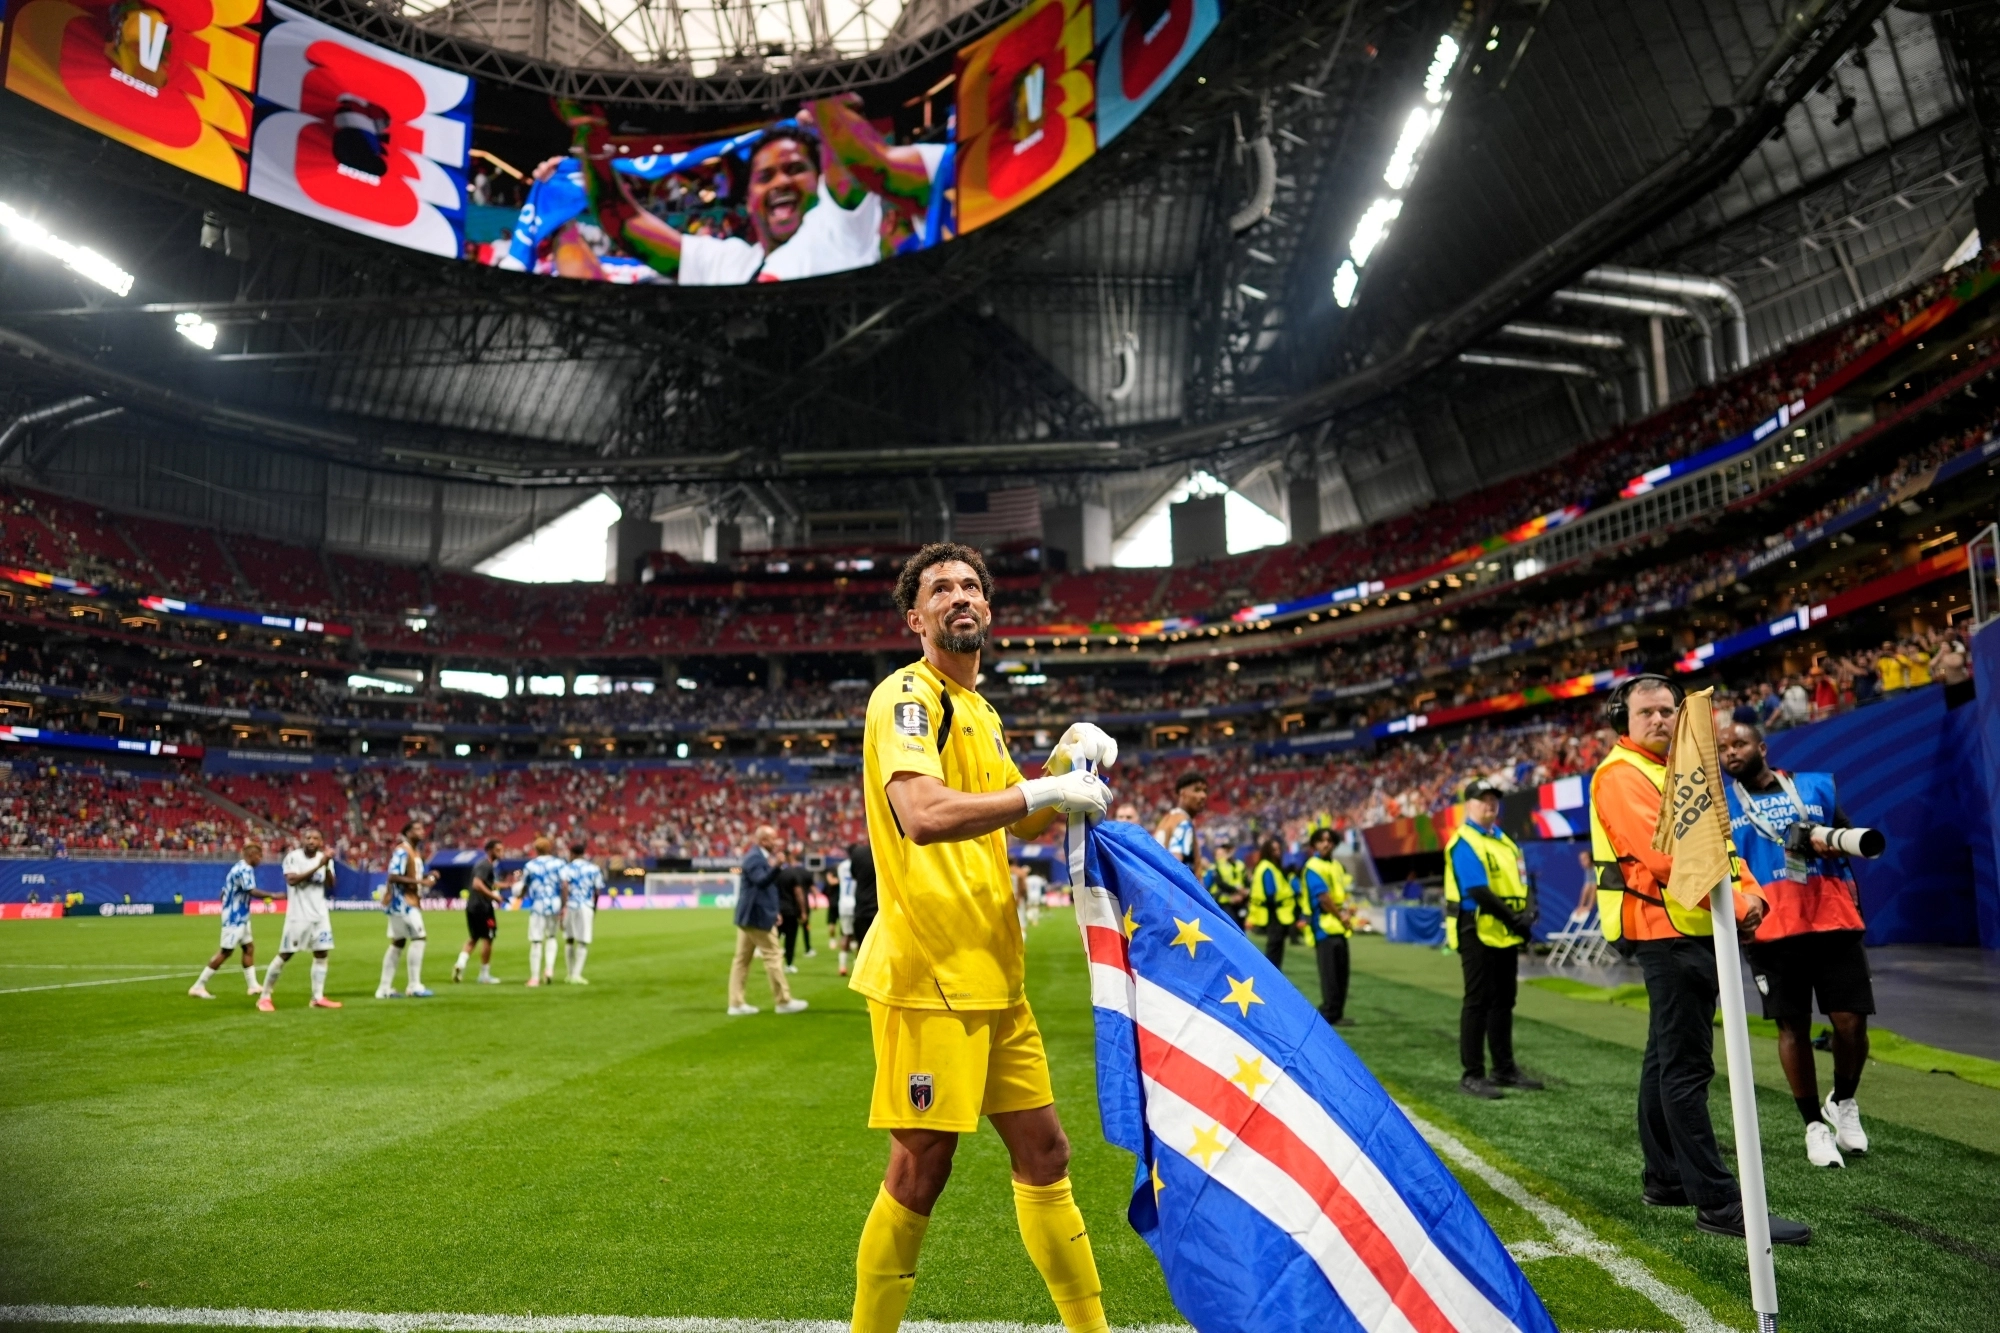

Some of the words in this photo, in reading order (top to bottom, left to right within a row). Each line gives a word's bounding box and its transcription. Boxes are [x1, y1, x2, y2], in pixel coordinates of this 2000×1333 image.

[110, 67, 159, 98] 2026
[22, 874, 45, 884] FIFA
[116, 904, 154, 915] HYUNDAI
